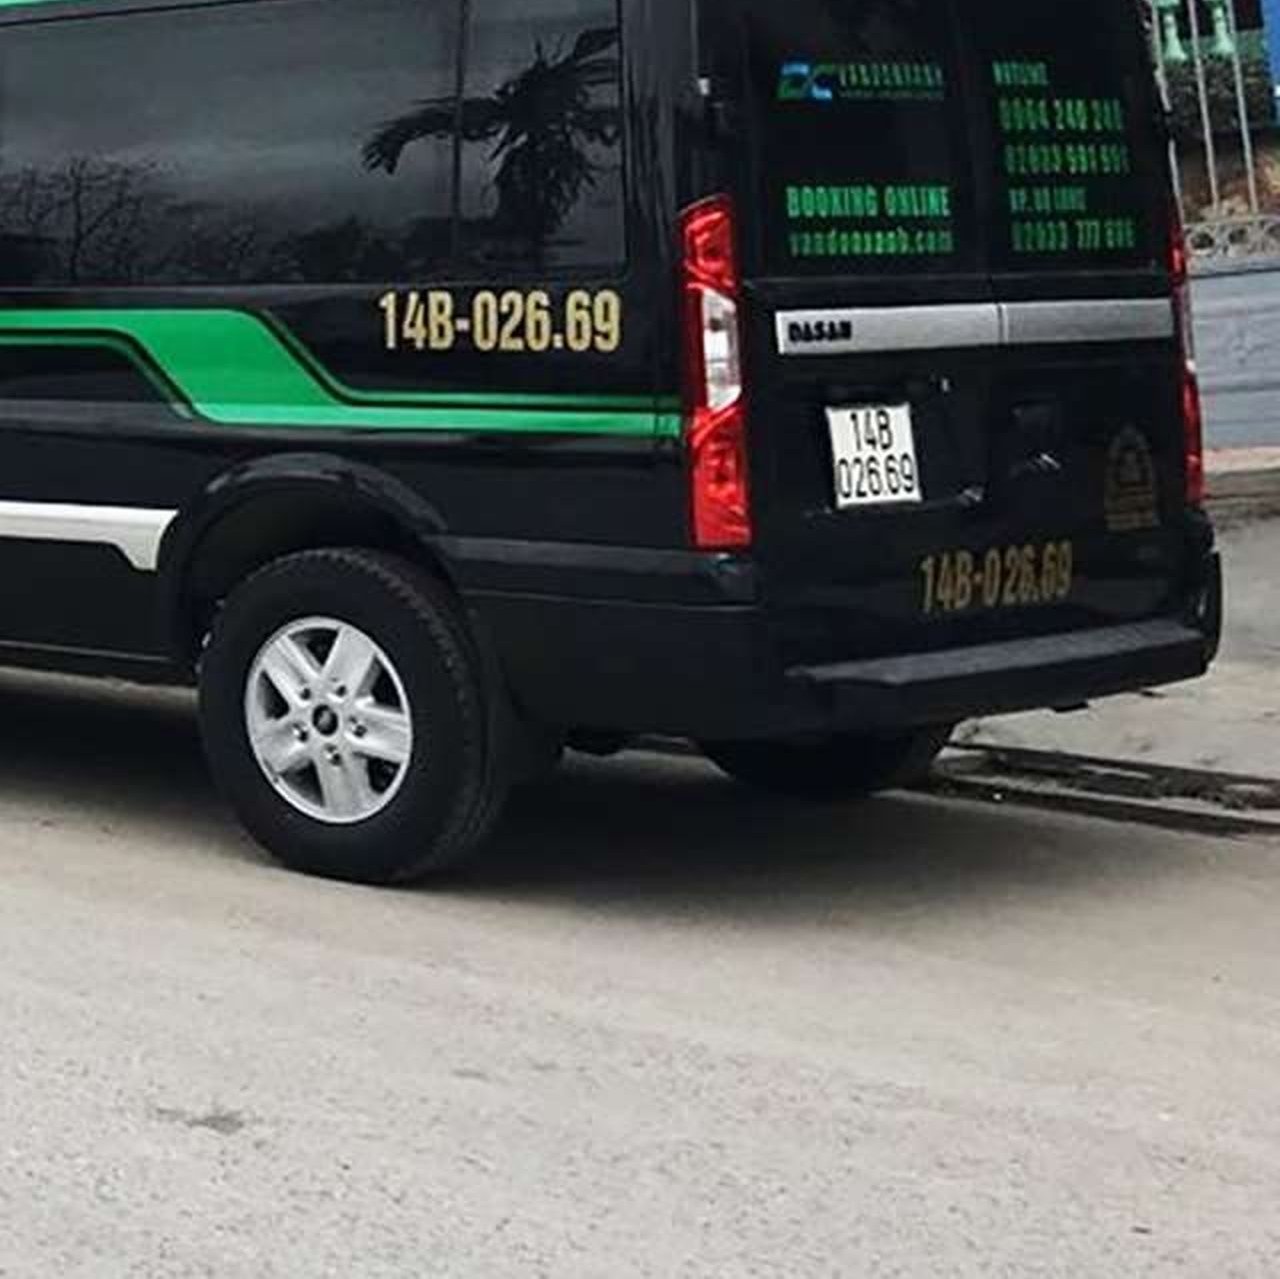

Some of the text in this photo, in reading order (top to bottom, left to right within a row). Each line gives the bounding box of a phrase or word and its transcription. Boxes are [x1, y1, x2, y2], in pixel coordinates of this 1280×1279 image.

[786, 184, 952, 218] BOOKING ONLINE
[378, 289, 622, 352] 14B-026.69
[787, 321, 853, 343] DASAN
[849, 409, 895, 452] 14B
[837, 453, 918, 500] 026.69
[919, 539, 1074, 614] 14B-026.69
